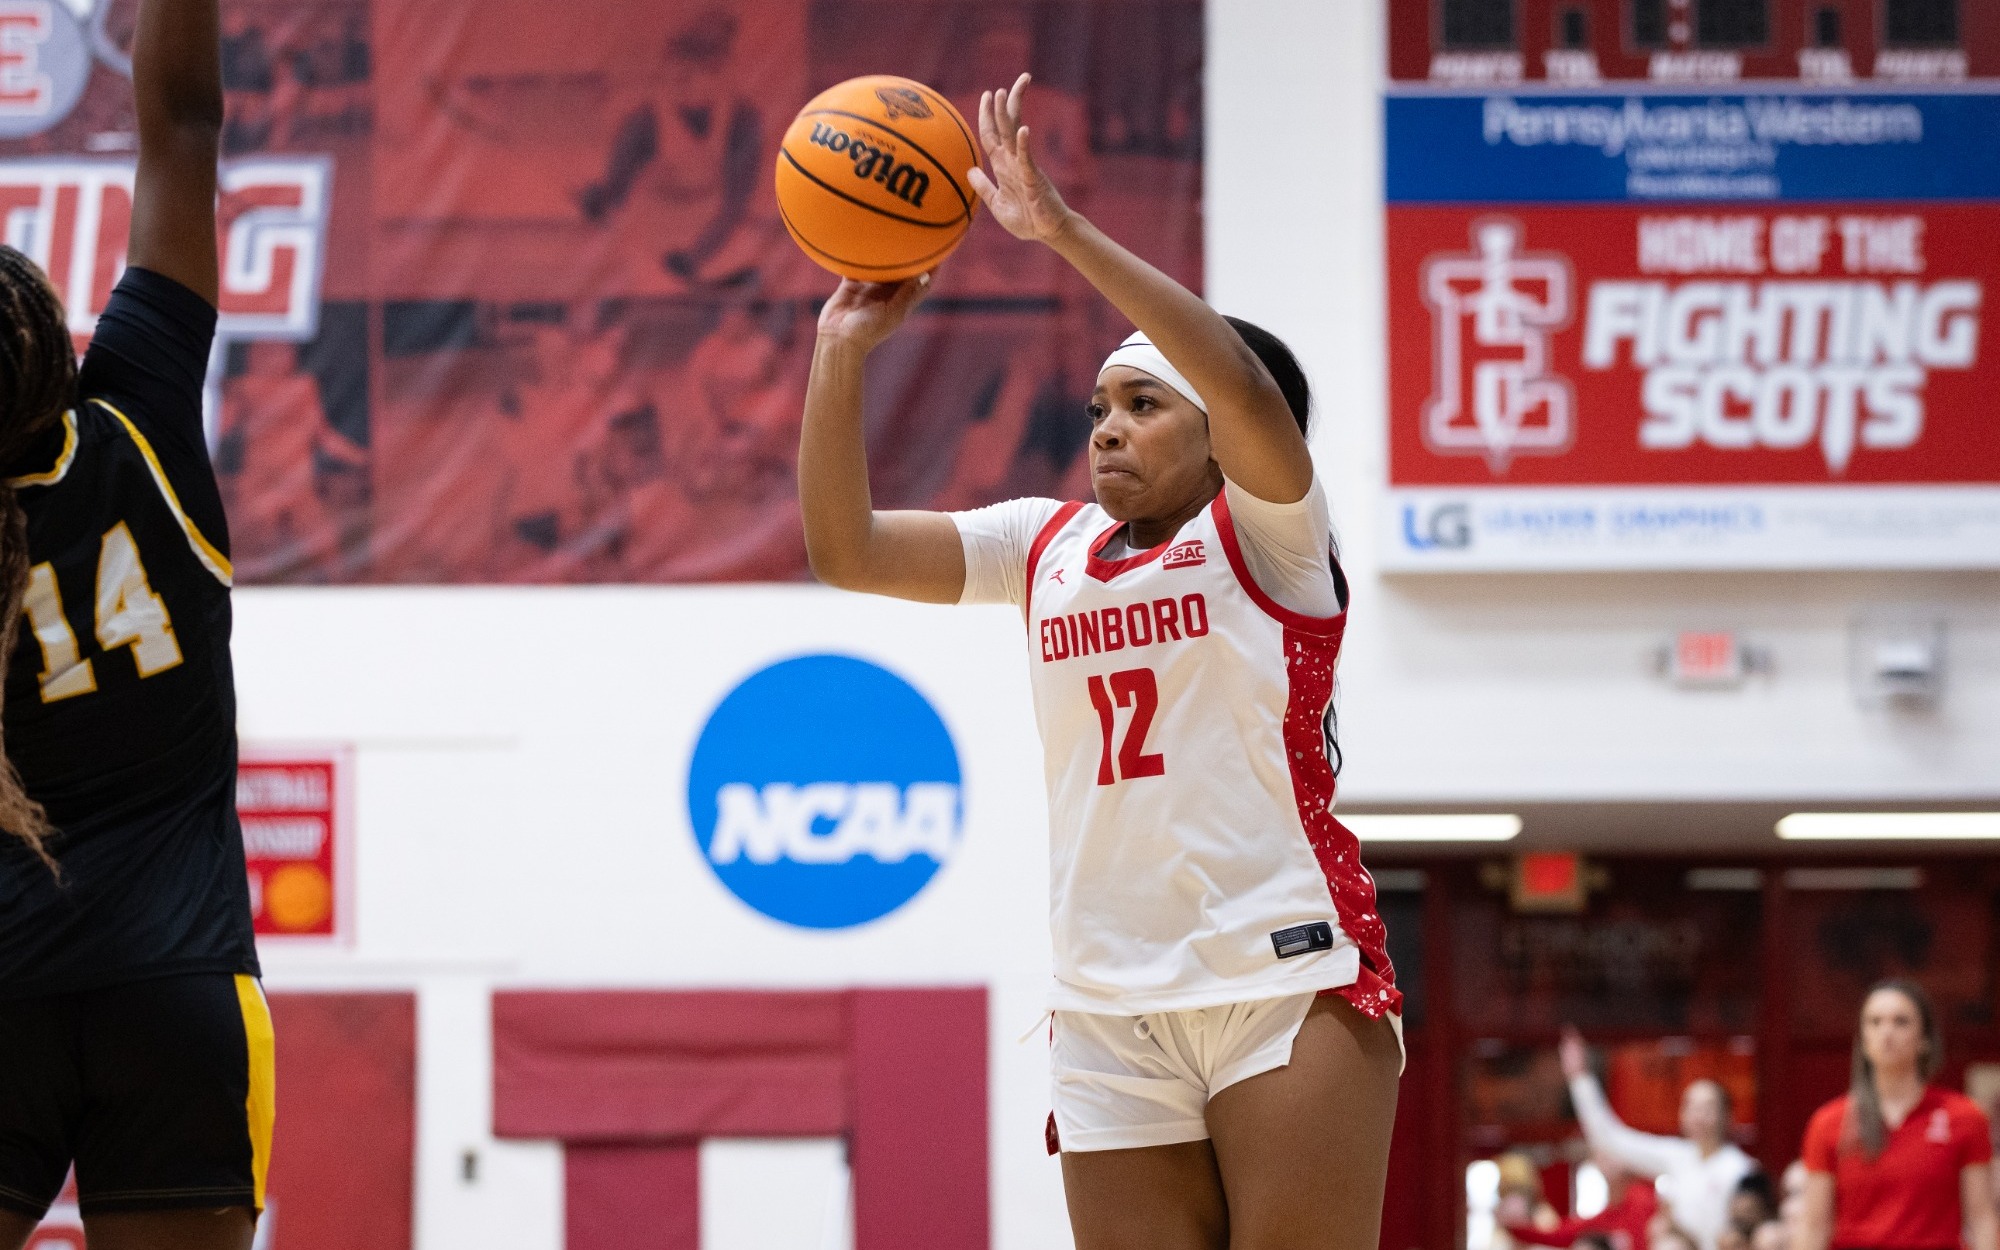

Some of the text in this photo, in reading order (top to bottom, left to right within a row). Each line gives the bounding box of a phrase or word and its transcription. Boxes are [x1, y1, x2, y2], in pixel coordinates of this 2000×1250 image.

[808, 121, 931, 209] Wilson
[1486, 98, 1921, 152] Pennsylvania Western
[1640, 217, 1923, 271] HOME OF THE
[1583, 281, 1979, 369] FIGHTING
[1640, 366, 1925, 472] SCOTS
[1162, 545, 1206, 565] PSAC
[1402, 502, 1474, 552] LG
[23, 519, 184, 704] 14
[1040, 592, 1209, 662] EDINBORO
[1087, 667, 1165, 786] 12
[709, 782, 960, 865] NCAA
